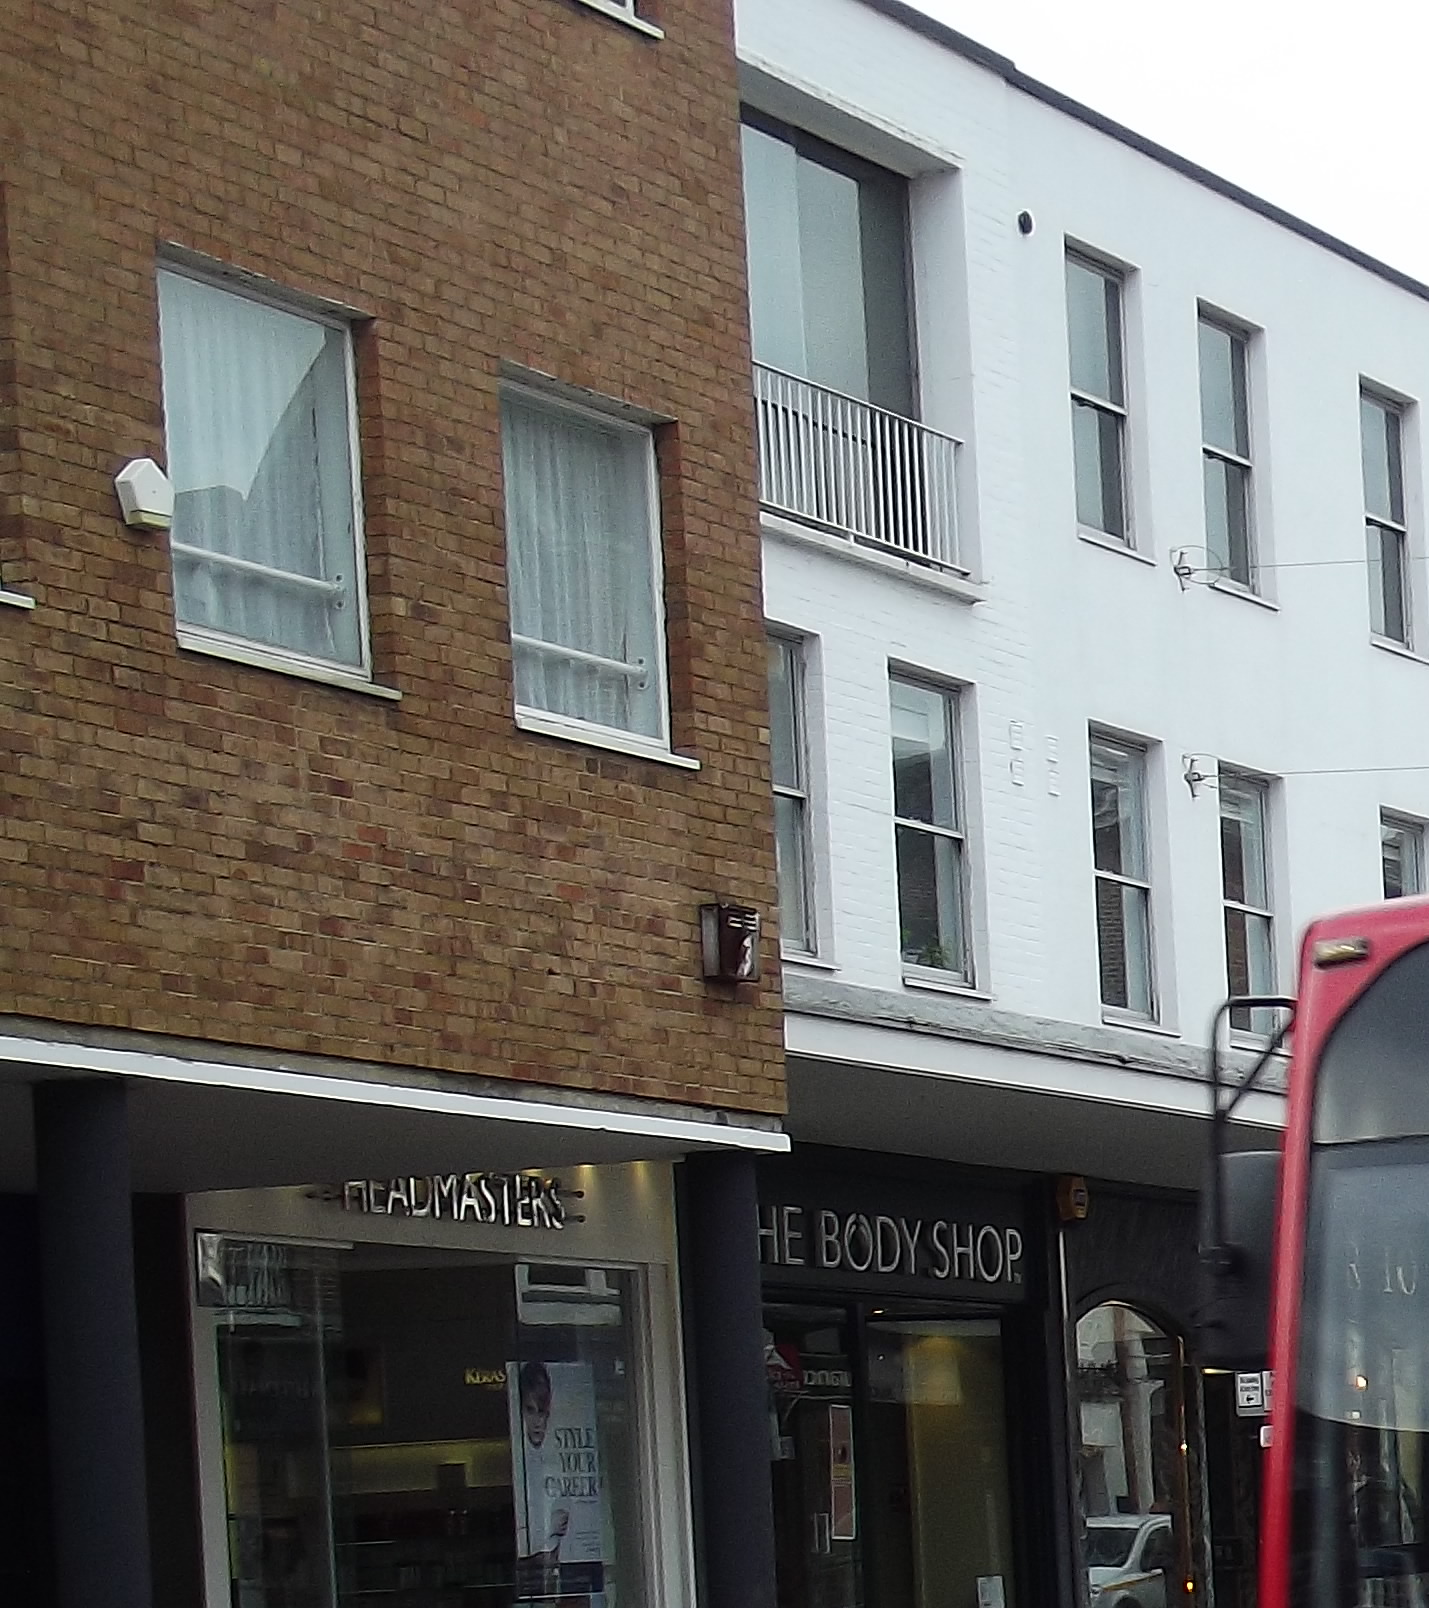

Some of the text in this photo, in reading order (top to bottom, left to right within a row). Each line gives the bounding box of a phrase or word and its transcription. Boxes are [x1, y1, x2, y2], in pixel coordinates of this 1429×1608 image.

[820, 1209, 922, 1275] BODY
[932, 1219, 1023, 1283] SHOP
[554, 1427, 597, 1450] STYLE
[558, 1451, 600, 1475] YOUR
